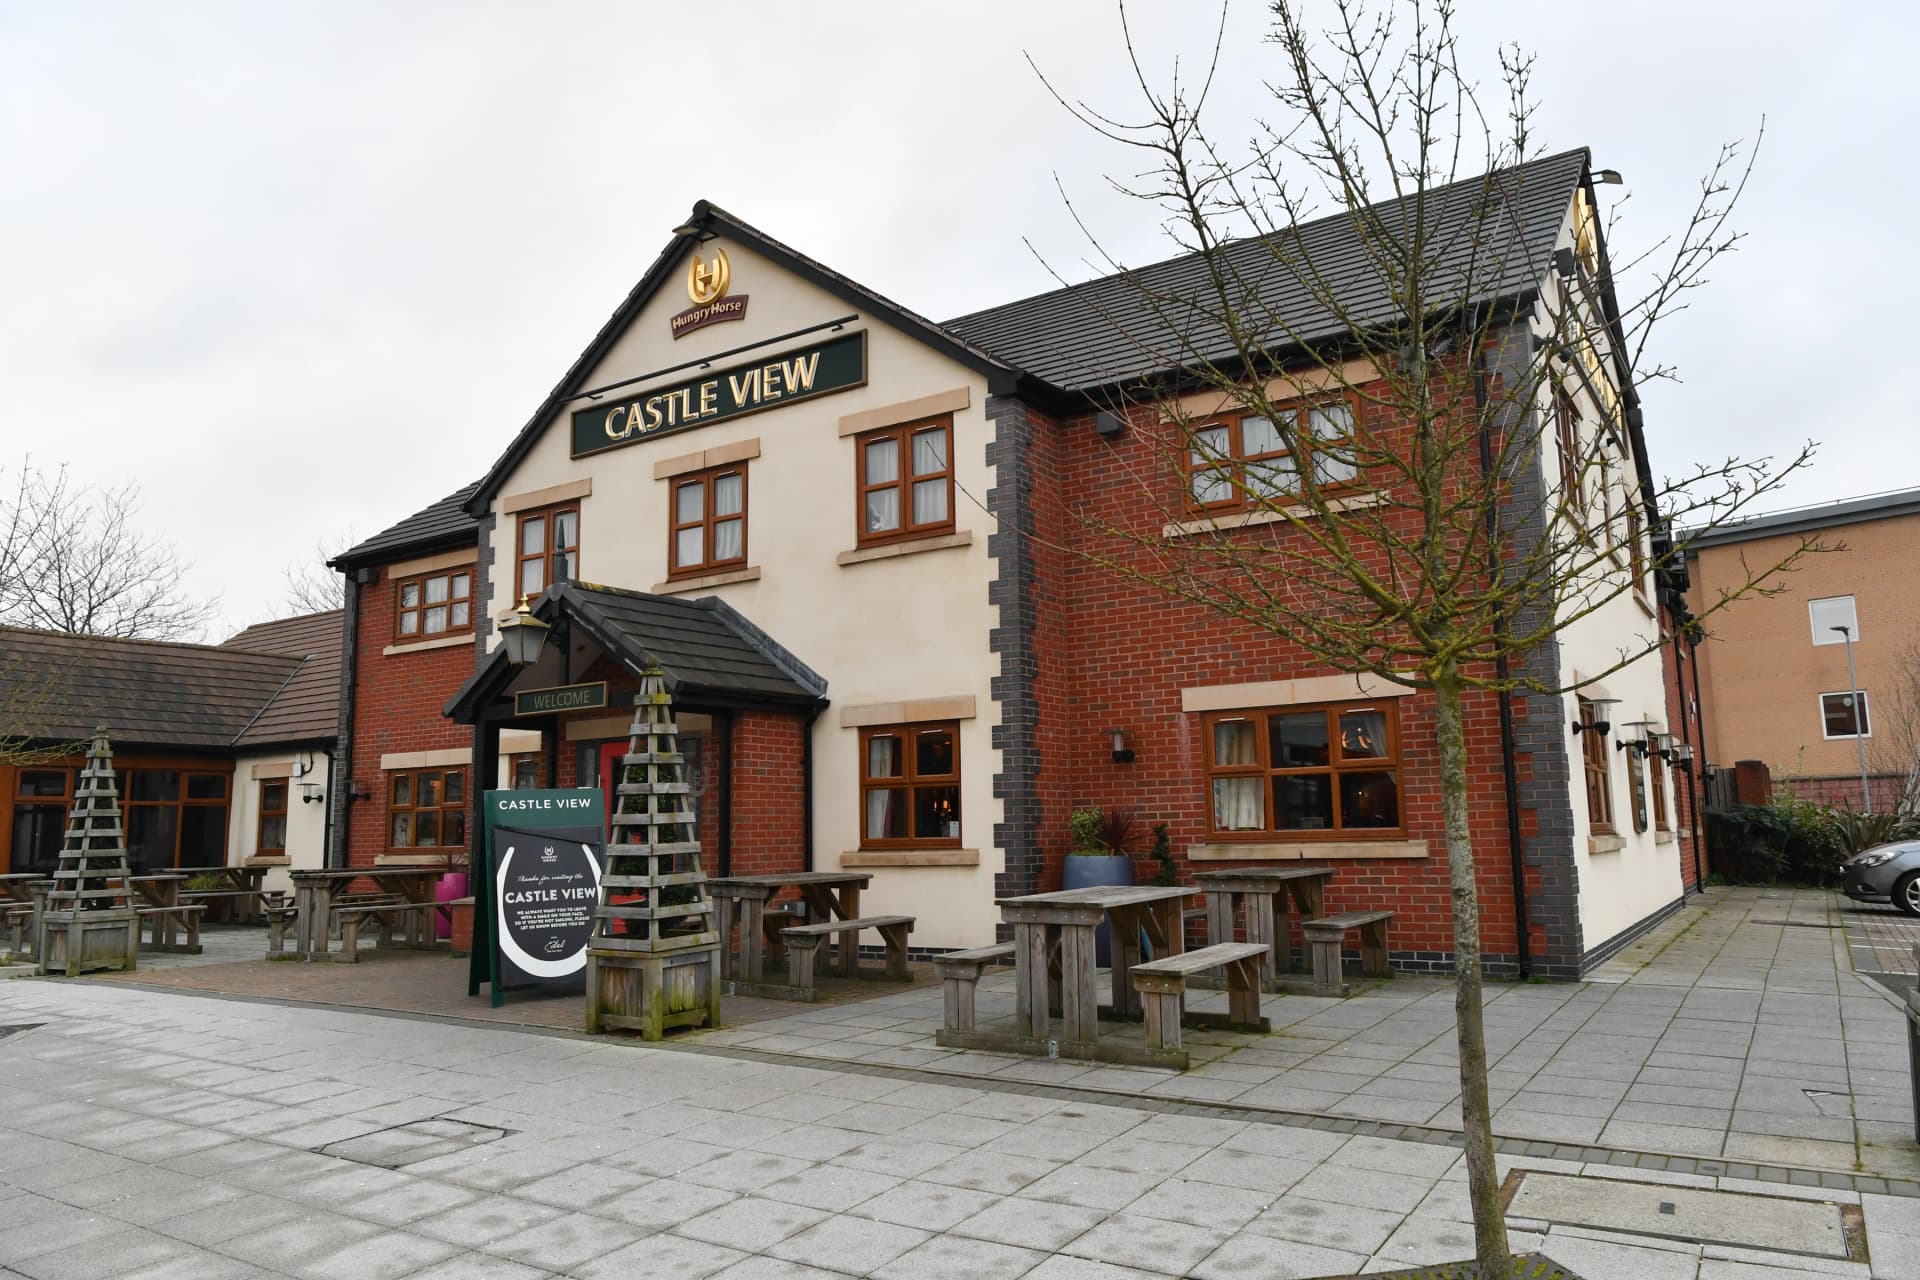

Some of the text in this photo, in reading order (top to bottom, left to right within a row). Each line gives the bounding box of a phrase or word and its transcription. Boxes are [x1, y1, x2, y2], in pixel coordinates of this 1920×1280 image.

[604, 352, 821, 440] CASTLE VIEW
[533, 689, 590, 710] WELCOME
[498, 798, 591, 810] CASTLE VIEW
[505, 887, 596, 904] CASTLE VIEW
